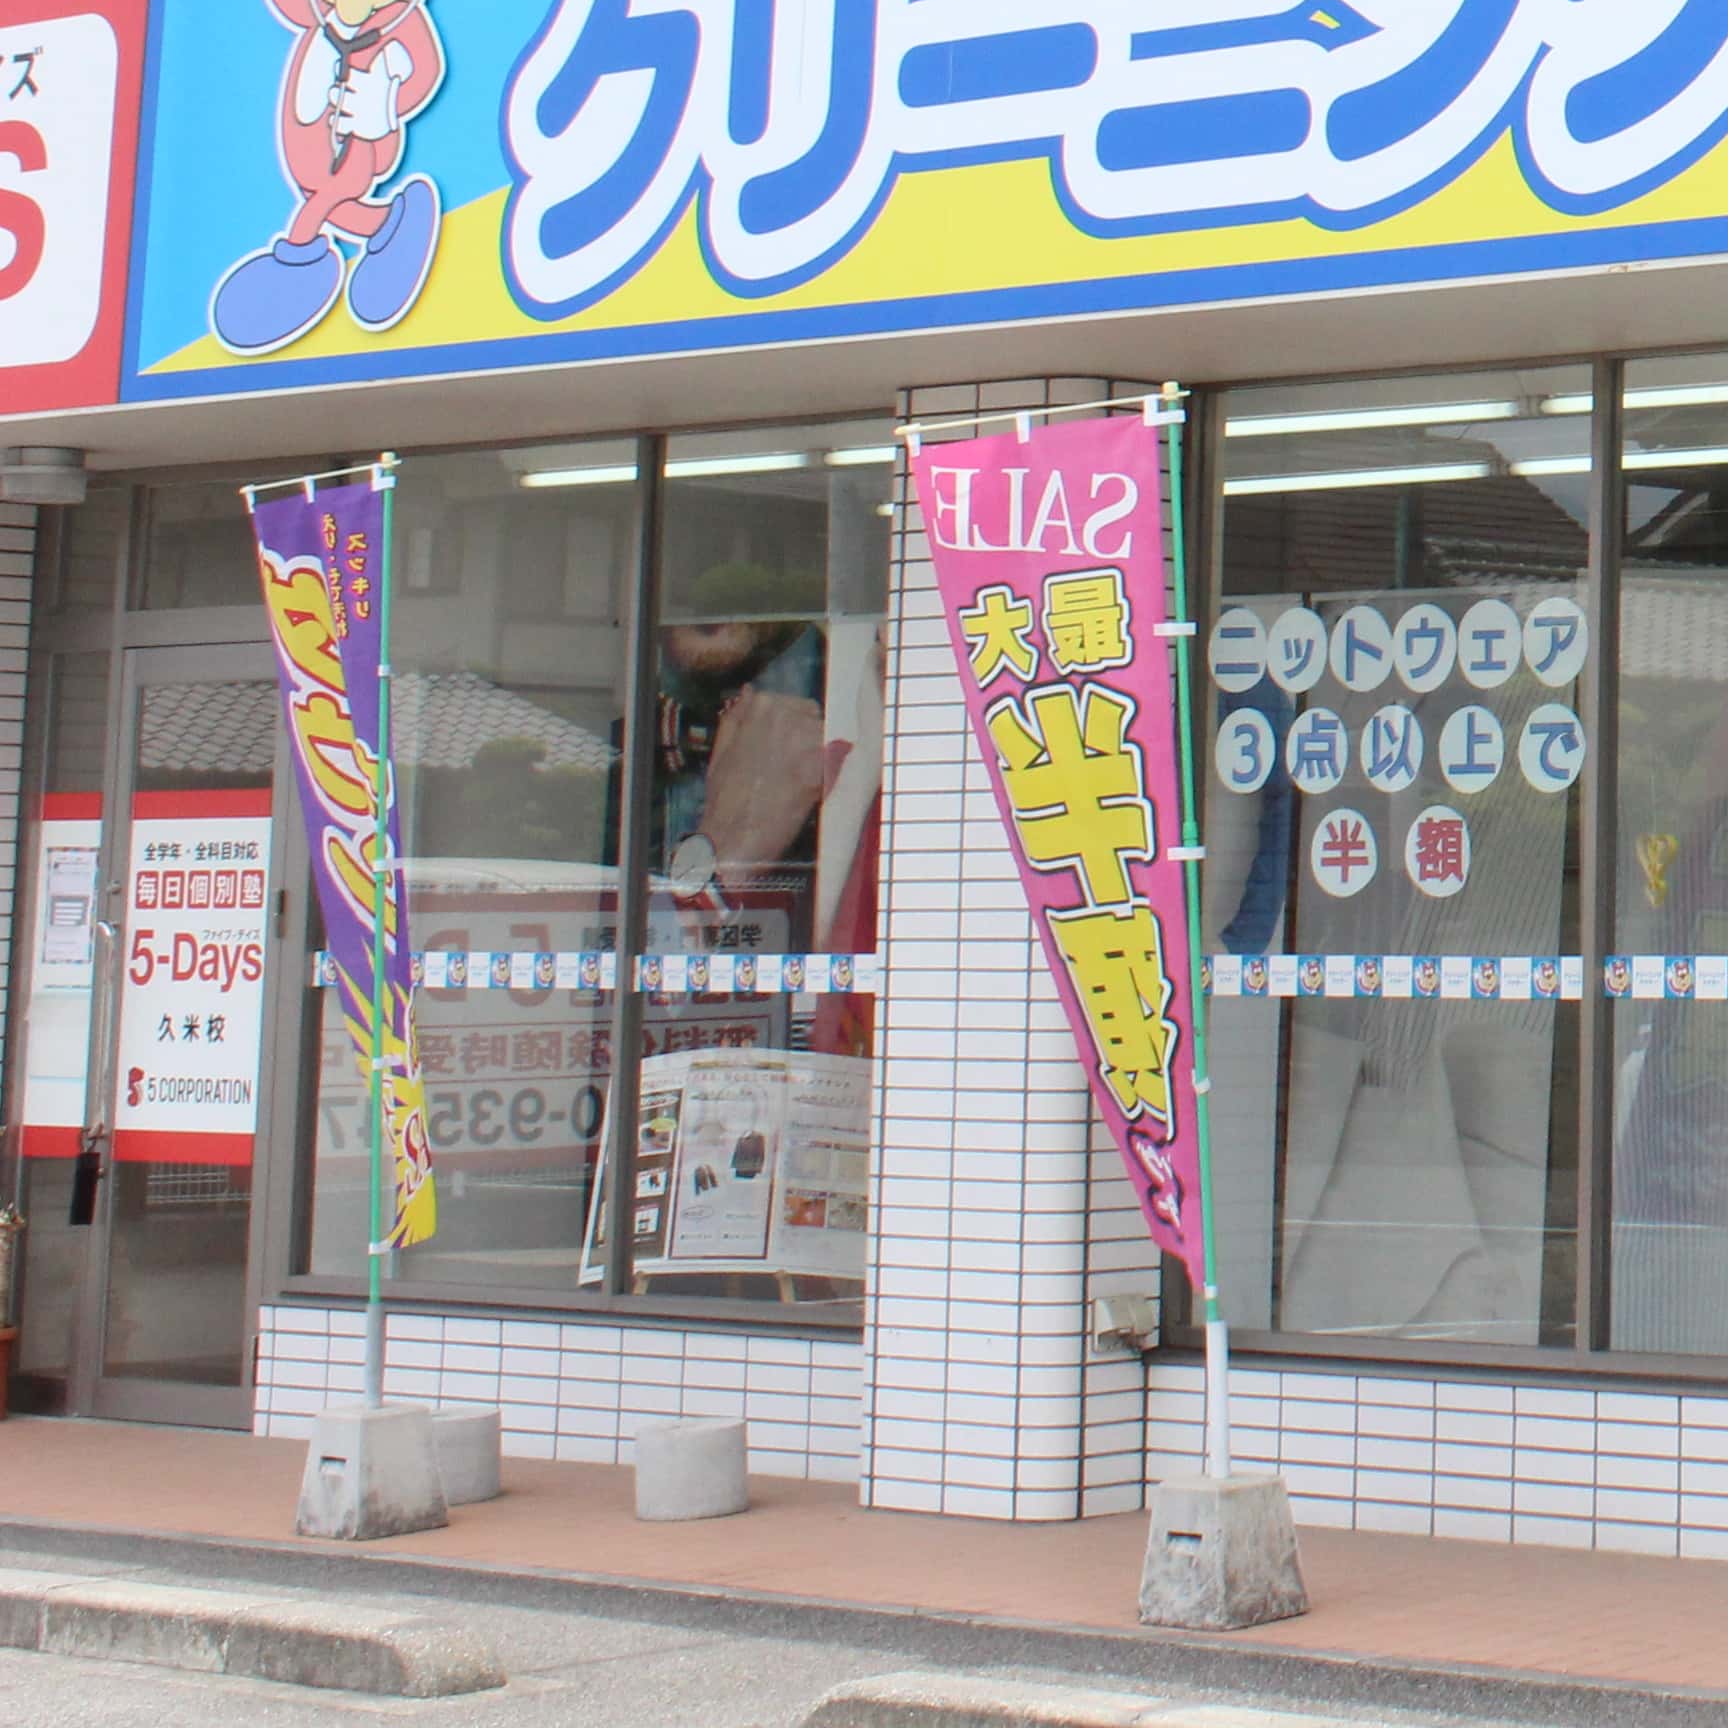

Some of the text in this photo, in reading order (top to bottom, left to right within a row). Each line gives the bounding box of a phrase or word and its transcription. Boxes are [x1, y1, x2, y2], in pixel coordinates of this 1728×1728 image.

[1214, 616, 1581, 683] ニットウェア
[1229, 712, 1582, 786] 3点以上で
[144, 841, 260, 862] 全学年・全科目対応
[1320, 816, 1465, 884] 半額
[136, 871, 266, 910] 毎日個別塾
[128, 929, 264, 994] 5-Days
[157, 1013, 227, 1044] 久米校
